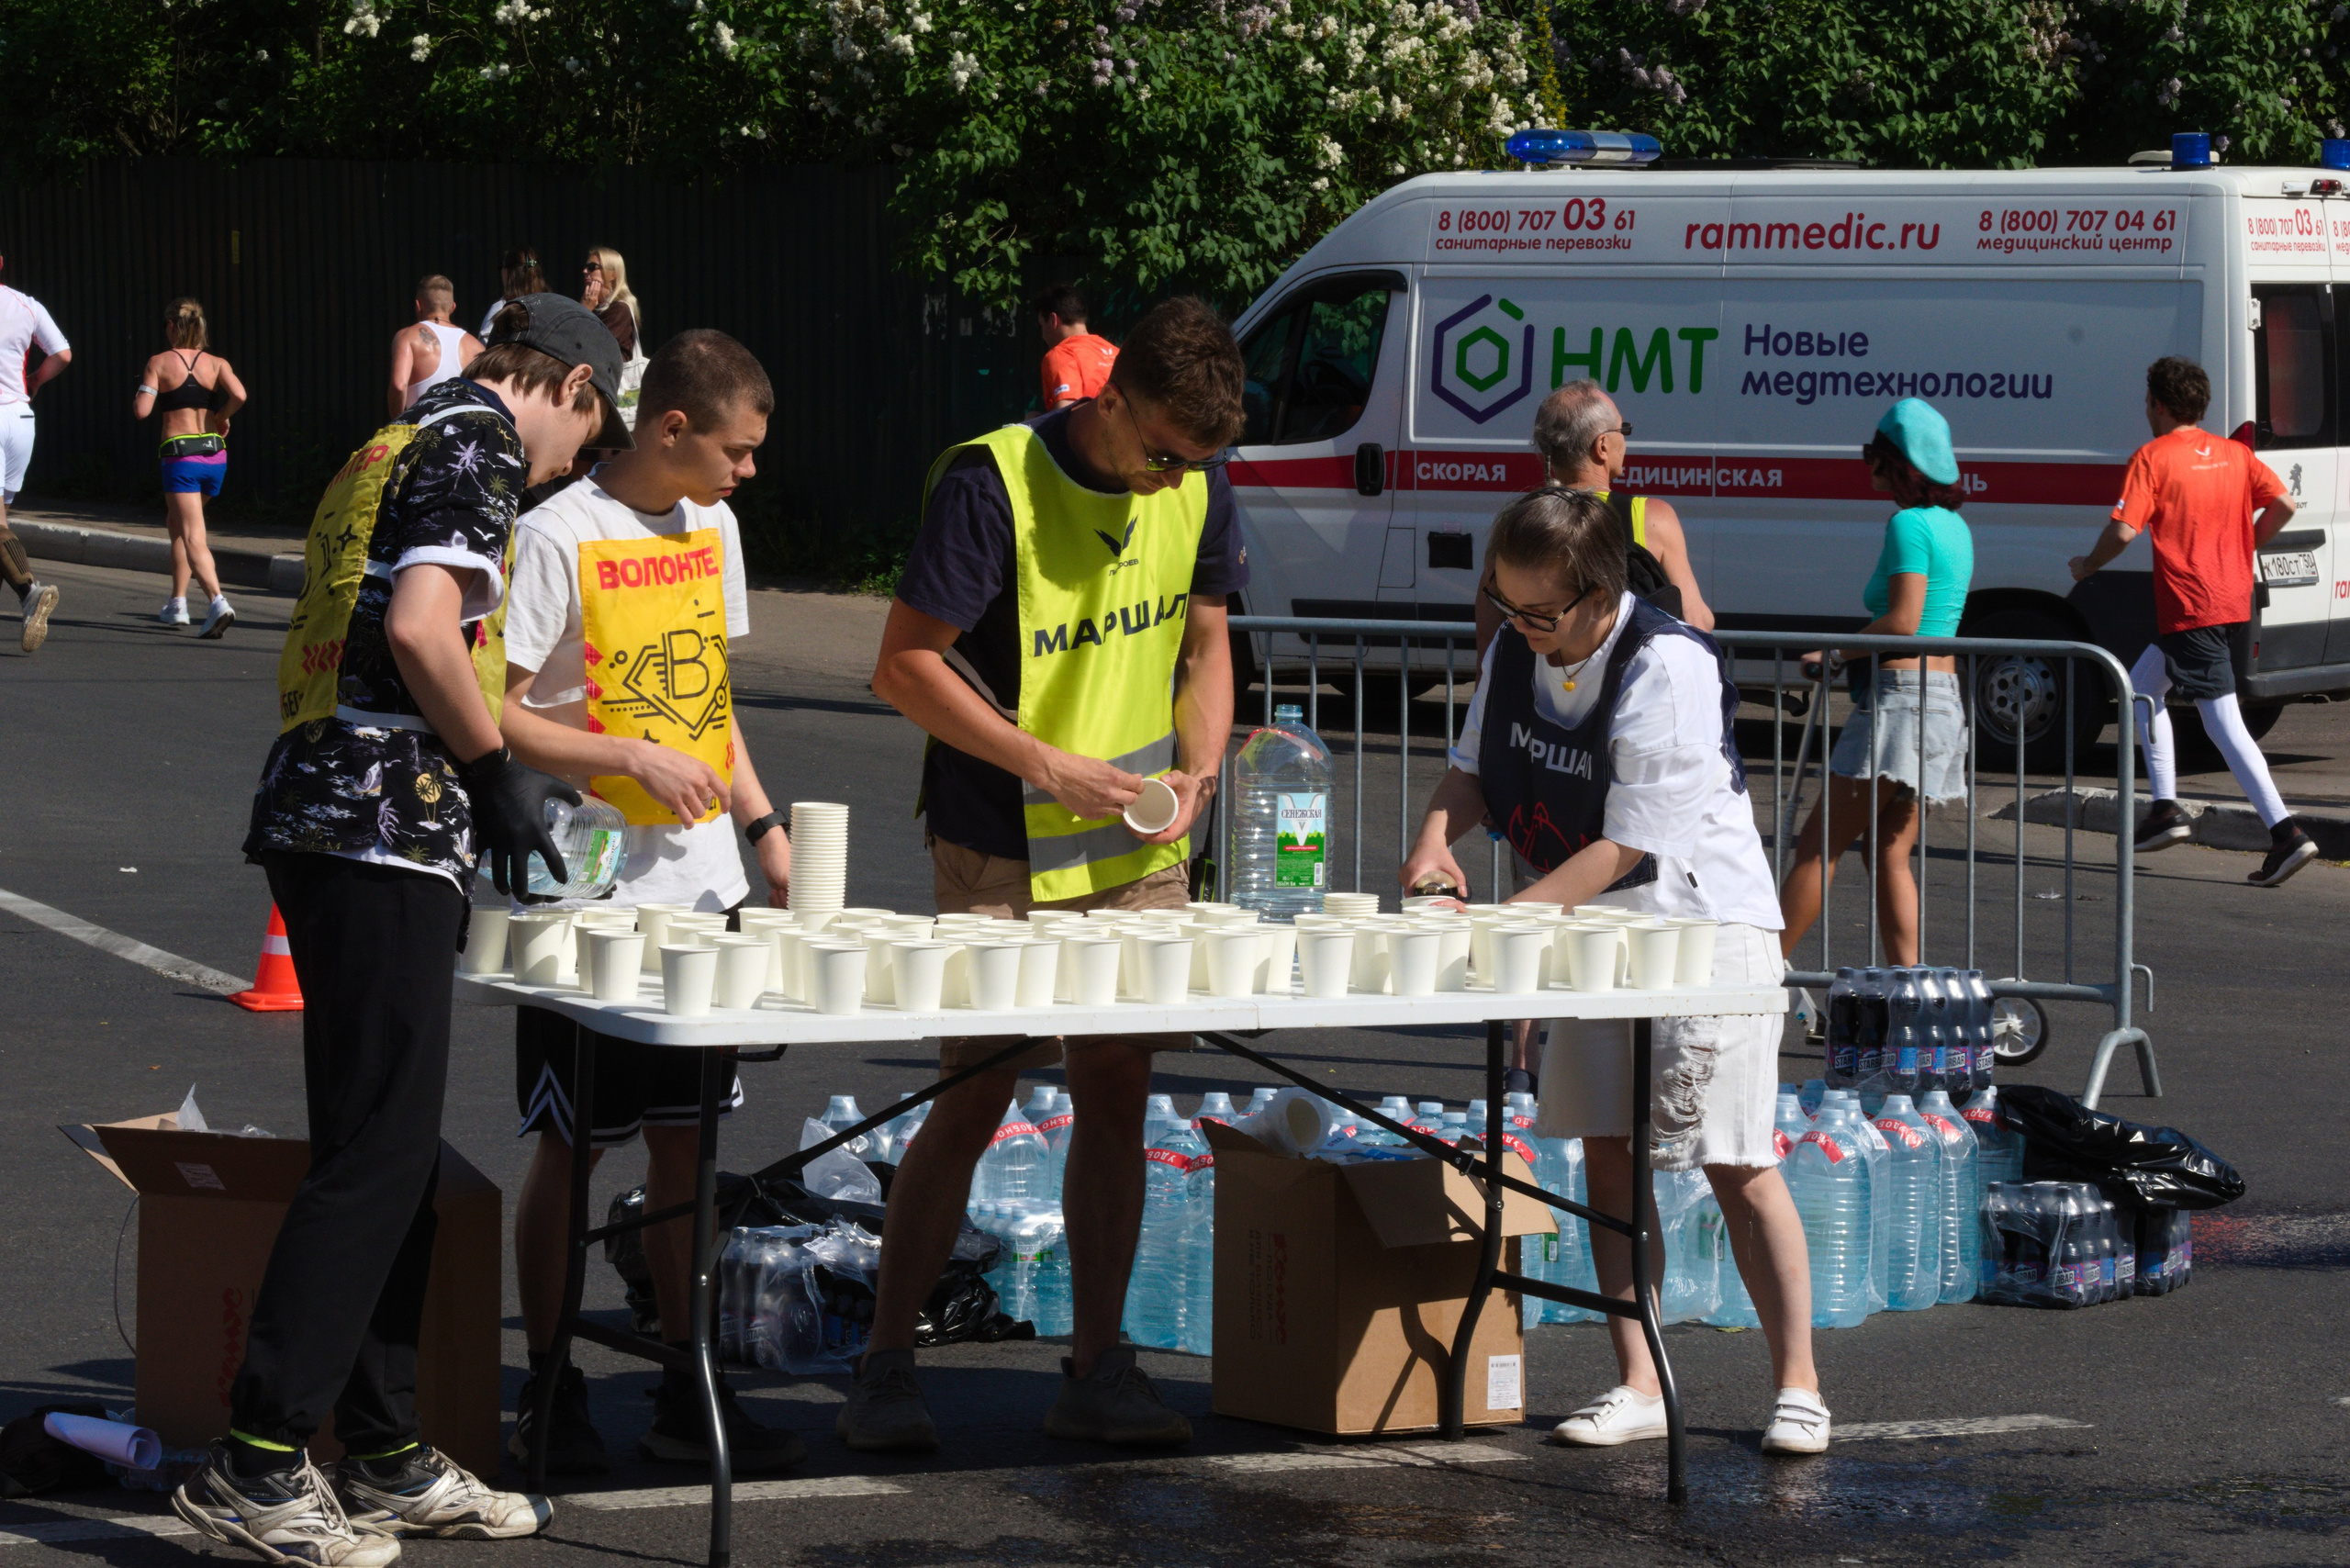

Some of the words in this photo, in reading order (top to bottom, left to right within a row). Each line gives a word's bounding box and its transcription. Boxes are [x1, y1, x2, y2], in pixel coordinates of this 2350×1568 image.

[1438, 210, 1451, 231] 8
[1458, 209, 1510, 234] (800)
[1517, 210, 1557, 231] 707
[1563, 197, 1606, 230] 03
[1614, 210, 1635, 230] 61
[1978, 210, 1993, 231] 8
[2000, 209, 2058, 234] (800)
[2066, 210, 2109, 231] 707
[2115, 210, 2145, 231] 04
[2153, 210, 2177, 231] 61
[2247, 218, 2255, 235] 8
[2255, 218, 2277, 237] (800)
[2278, 218, 2293, 235] 707
[2295, 208, 2312, 236] 03
[2315, 219, 2324, 236] 61
[2333, 220, 2339, 237] 8
[1435, 238, 1542, 253] санитарные
[1546, 234, 1632, 253] перевозки
[1684, 213, 1941, 251] rammedic.ru
[1976, 233, 2103, 254] медицинский
[2109, 237, 2173, 254] центр
[2251, 241, 2292, 253] санитарные
[2293, 239, 2326, 254] перевозки
[1745, 323, 1869, 356] Новые
[1550, 327, 1719, 394] НМТ
[1740, 370, 2053, 405] медтехнологии
[1416, 462, 1506, 482] СКОРАЯ
[1613, 465, 1783, 489] ЕДИЦИНСКАЯ
[597, 545, 720, 590] ВОЛОНТЕ
[1033, 592, 1188, 657] МАРШАЛ
[1509, 722, 1593, 780] МРШАЛ
[1281, 809, 1322, 819] СЕНЕЖСКАЯ
[1147, 1150, 1176, 1163] УДОБ
